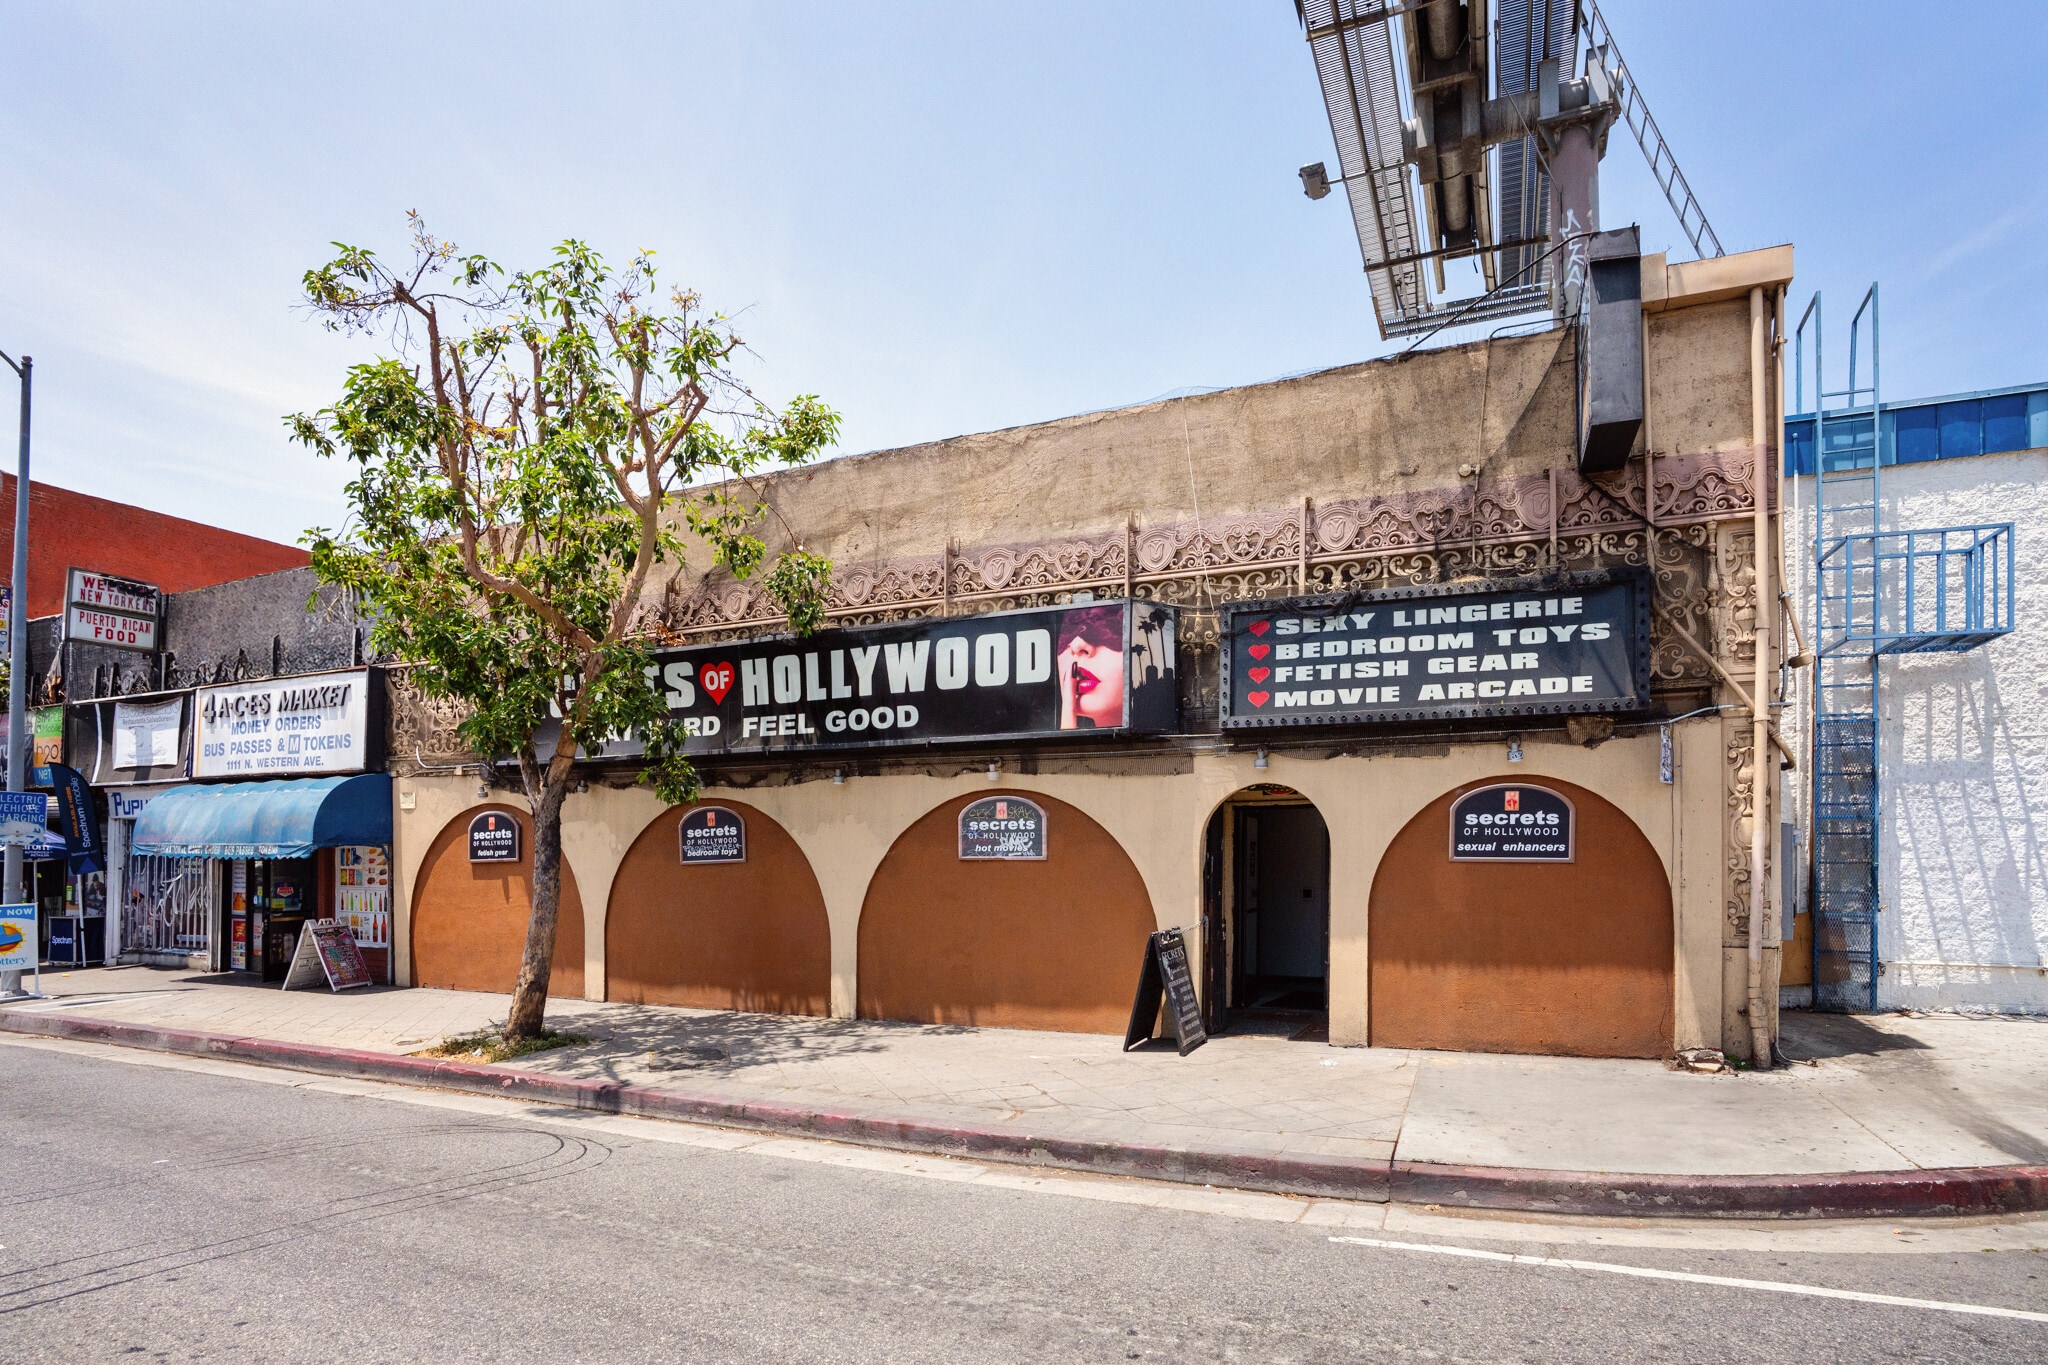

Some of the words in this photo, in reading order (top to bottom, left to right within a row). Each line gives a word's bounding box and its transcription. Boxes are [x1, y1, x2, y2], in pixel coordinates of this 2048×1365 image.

[80, 588, 103, 603] NEW
[79, 611, 117, 628] PUERTO
[122, 618, 151, 634] RICAN
[1275, 613, 1376, 636] SEXY
[1393, 596, 1583, 628] LINGERIE
[94, 627, 136, 643] FOOD
[1275, 632, 1474, 661] BEDROOM
[1493, 622, 1611, 647] TOYS
[704, 670, 730, 691] OF
[741, 629, 1052, 707] HOLLYWOOD
[1275, 659, 1409, 683] FETISH
[1428, 652, 1539, 675] GEAR
[1275, 685, 1400, 708] MOVIE
[1418, 675, 1593, 701] ARCADE
[202, 693, 216, 723] 4
[276, 684, 351, 713] MARKET
[231, 718, 270, 736] MONEY
[275, 715, 322, 731] ORDERS
[742, 713, 815, 738] FEEL
[825, 705, 919, 733] GOOD
[204, 742, 225, 757] BUS
[230, 739, 272, 755] PASSES
[277, 737, 285, 751] &
[303, 733, 352, 750] TOKENS
[226, 760, 241, 770] 1111
[244, 759, 253, 769] N.
[257, 756, 299, 768] WESTERN
[303, 755, 324, 767] AVE.
[71, 777, 83, 805] mobile
[0, 794, 43, 805] LECTRIC
[0, 813, 45, 823] HARGING
[969, 818, 1036, 830] secrets
[1465, 810, 1560, 825] secrets
[77, 808, 91, 848] Spectrum
[473, 829, 512, 840] secrets
[686, 825, 738, 838] secrets
[983, 831, 1036, 839] HOLLYWOOD
[1463, 828, 1479, 836] OF
[1484, 827, 1559, 836] HOLLYWOOD
[697, 837, 738, 845] HOLLYWOOD
[975, 844, 992, 852] hot
[993, 844, 1029, 852] movies
[1457, 842, 1497, 851] sexual
[1502, 842, 1566, 852] enhancers
[477, 849, 494, 857] fetish
[686, 849, 720, 857] bedroom
[721, 848, 738, 857] toys
[6, 908, 33, 916] NOW
[52, 935, 73, 946] Spectrum
[0, 957, 27, 965] ttery
